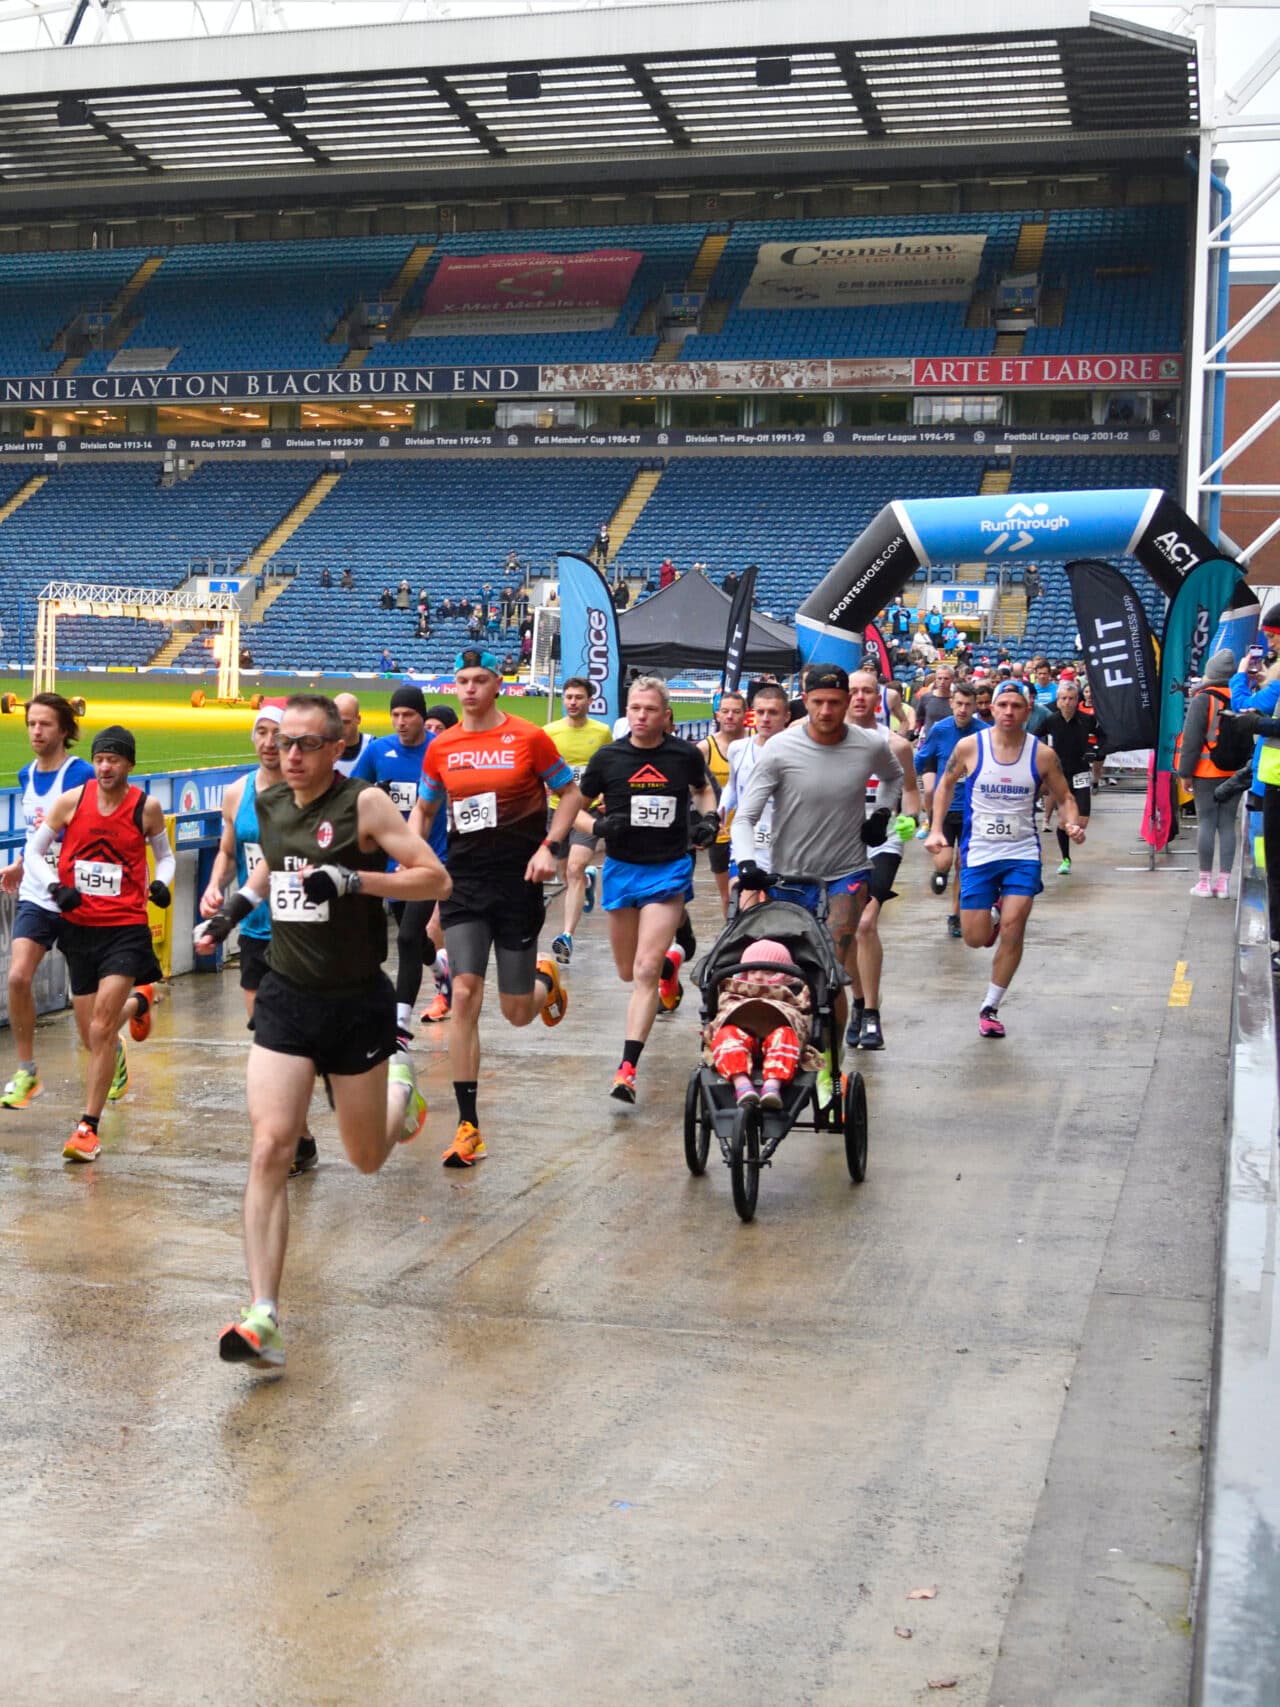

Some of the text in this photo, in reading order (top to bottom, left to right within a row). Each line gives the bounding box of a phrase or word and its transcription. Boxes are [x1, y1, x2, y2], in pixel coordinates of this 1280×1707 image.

[780, 242, 956, 266] Cronshaw
[920, 358, 1153, 383] ARTE ET LABORE
[92, 375, 229, 399] CLAYTON
[247, 370, 435, 395] BLACKBURN
[453, 369, 519, 391] END
[405, 436, 434, 445] Division
[437, 437, 458, 445] Three
[534, 435, 549, 444] Full
[590, 435, 606, 445] Cup
[686, 433, 806, 444] Division Two Play-Off 1991-92
[852, 433, 885, 442] Premier
[888, 433, 917, 443] League
[1004, 431, 1129, 442] Football League Cup 2001-02
[5, 442, 24, 451] Shield
[26, 442, 43, 450] 1912
[80, 441, 107, 450] Division
[109, 441, 122, 449] One
[201, 439, 215, 449] Cup
[217, 439, 246, 448] 1927-28
[286, 438, 315, 447] Division
[316, 438, 331, 447] Two
[980, 515, 1069, 532] RunThrough
[829, 536, 904, 622] SPORTSSHOES.COM
[1123, 595, 1134, 612] APP
[1127, 613, 1140, 647] FITNESS
[1133, 649, 1145, 677] RATED
[421, 685, 457, 694] sky be
[508, 686, 524, 696] be
[1142, 689, 1151, 708] THE
[448, 750, 516, 769] PRIME
[980, 784, 1030, 794] BLACKBURN
[391, 793, 410, 804] 04
[460, 806, 489, 825] 990
[638, 806, 670, 820] 347
[986, 824, 1012, 835] 201
[80, 872, 113, 888] 434
